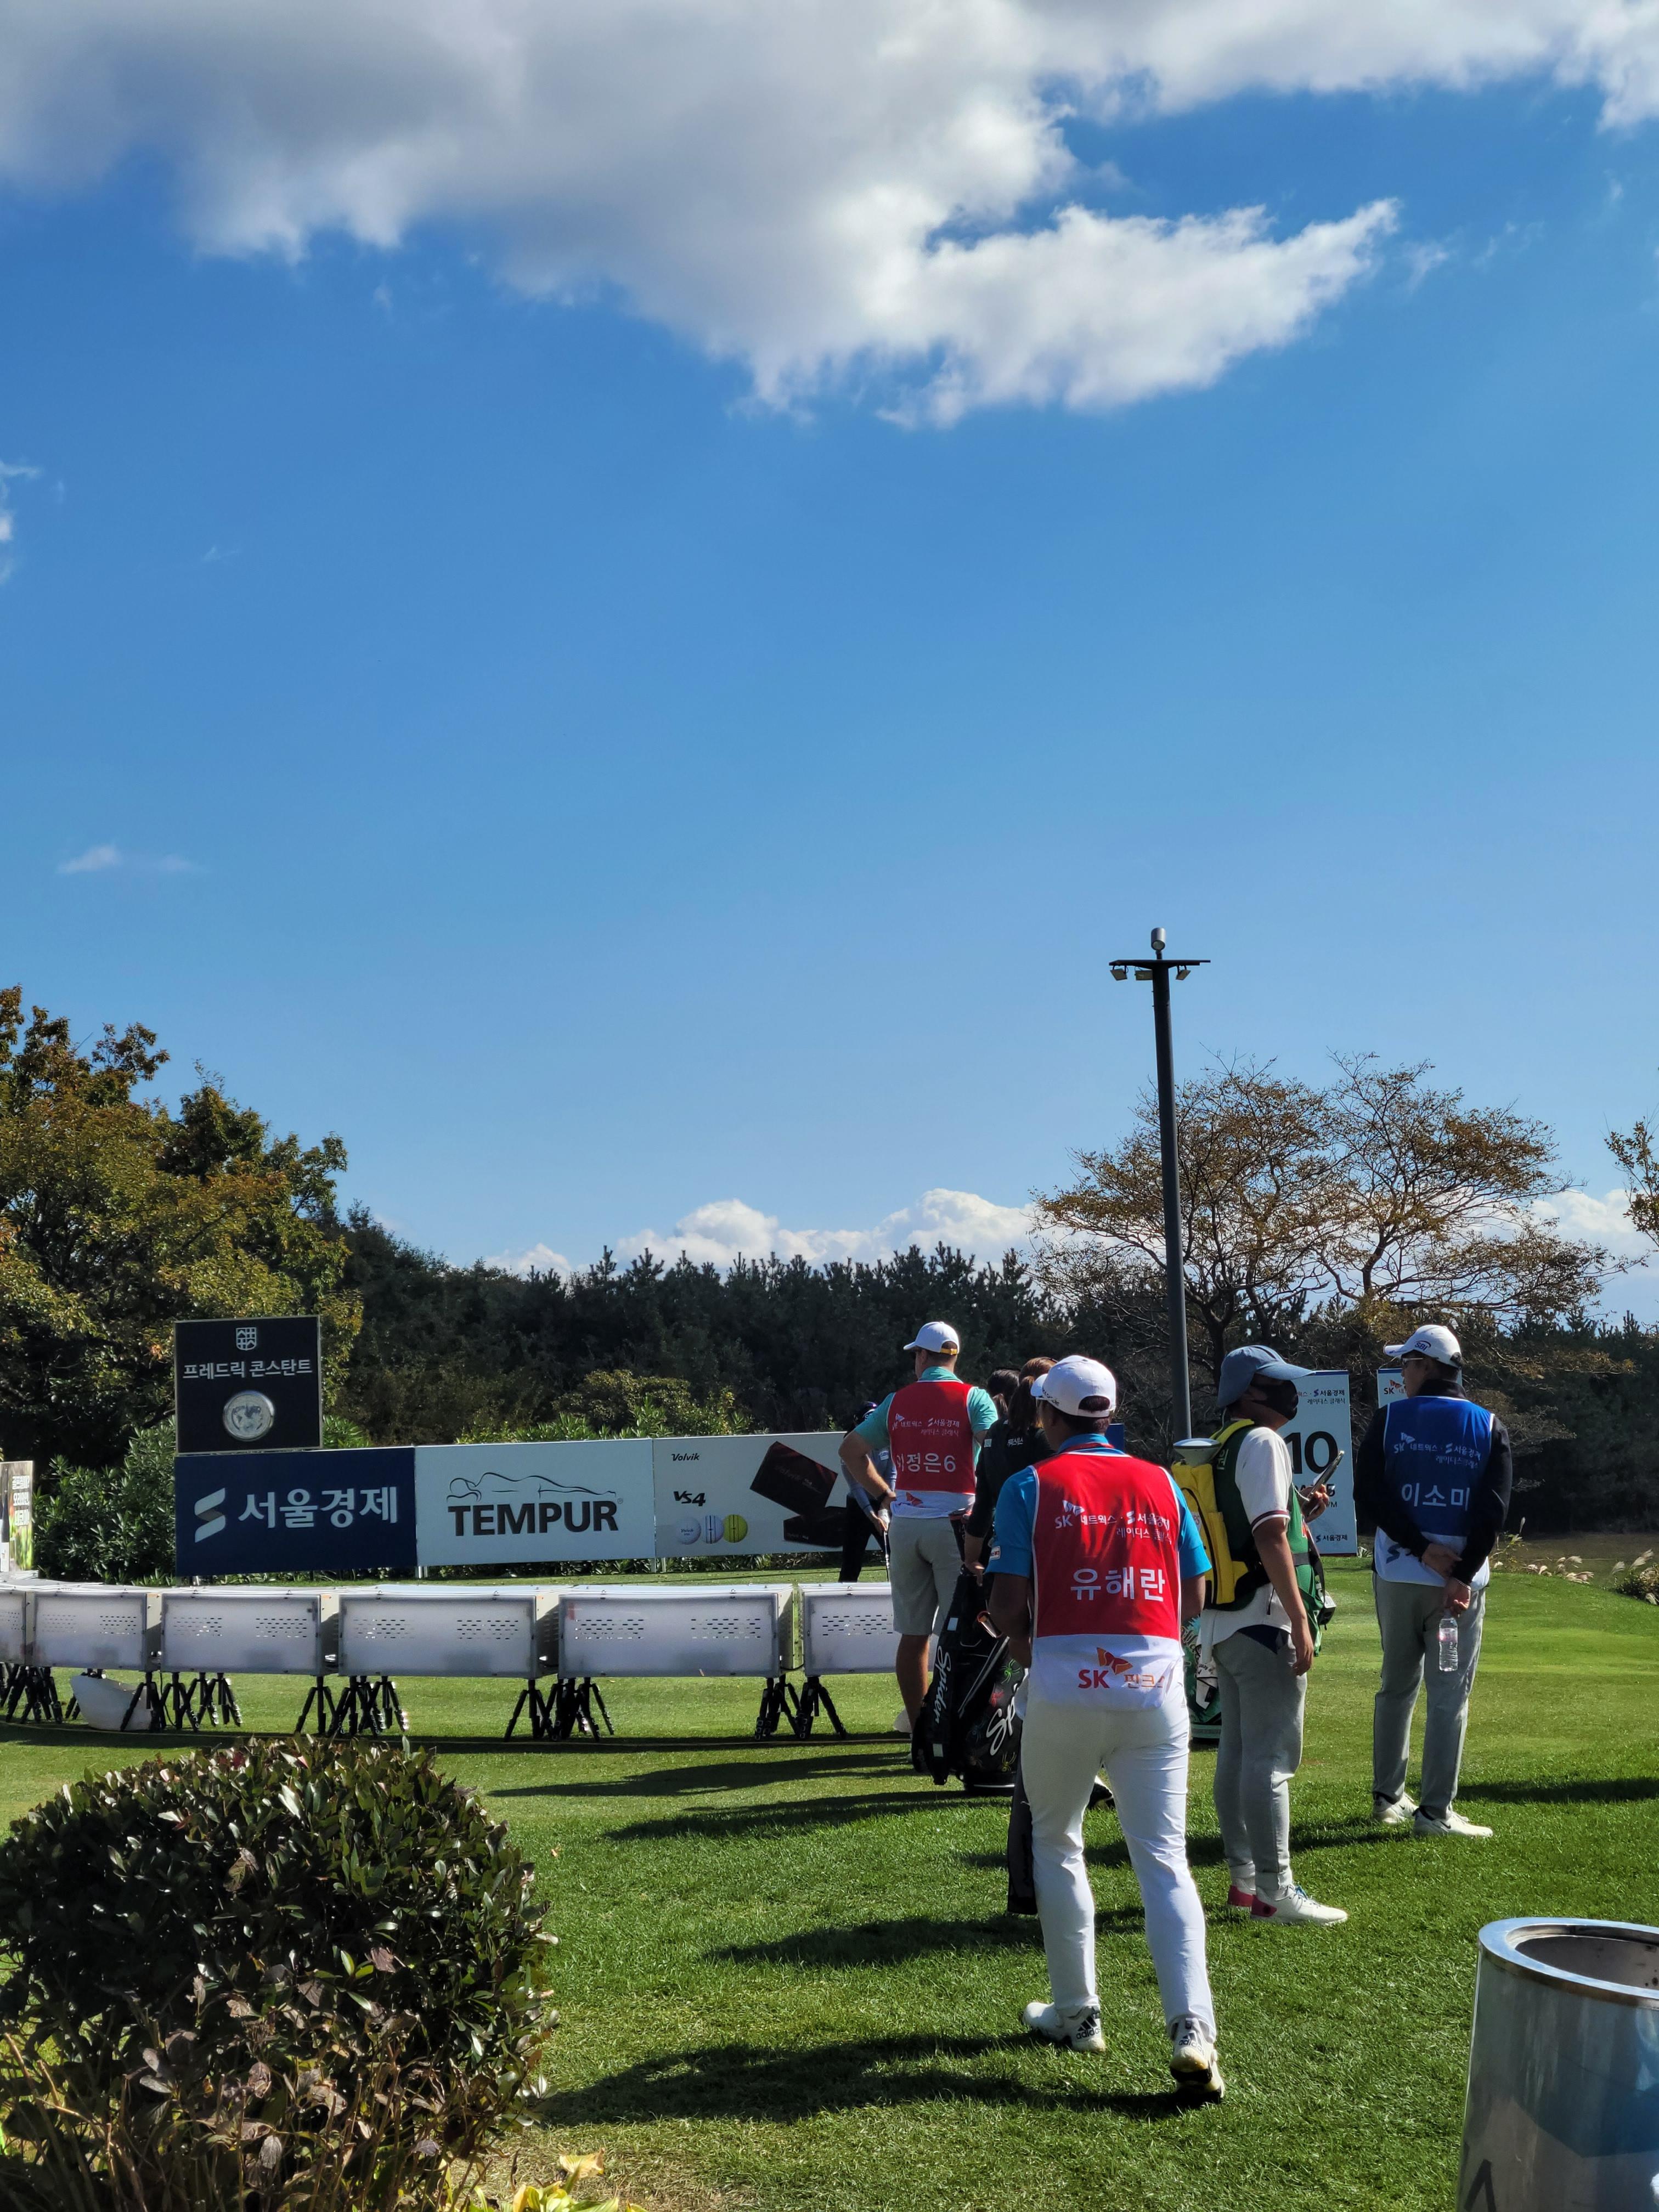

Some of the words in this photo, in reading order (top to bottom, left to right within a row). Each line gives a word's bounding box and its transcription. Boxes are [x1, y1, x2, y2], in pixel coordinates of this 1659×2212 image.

[1415, 1342, 1429, 1351] SBI
[183, 1359, 246, 1380] 프레드릭
[249, 1358, 313, 1378] 콘스탄트
[934, 1419, 960, 1427] 서울경제
[672, 1453, 701, 1462] Volvik
[1283, 1431, 1339, 1475] 10
[1394, 1442, 1405, 1453] SK
[896, 1452, 956, 1473] 이정은6
[674, 1491, 706, 1507] VS4
[1401, 1482, 1470, 1511] 이소미
[238, 1486, 398, 1529] 서울경제
[448, 1500, 619, 1537] TEMPUR
[1055, 1514, 1074, 1529] SK
[1080, 1515, 1118, 1525] 네트웍스
[1116, 1527, 1151, 1539] 레이디스
[1070, 1566, 1166, 1602] 유해란
[933, 1645, 951, 1724] Spider
[1078, 1669, 1110, 1689] SK
